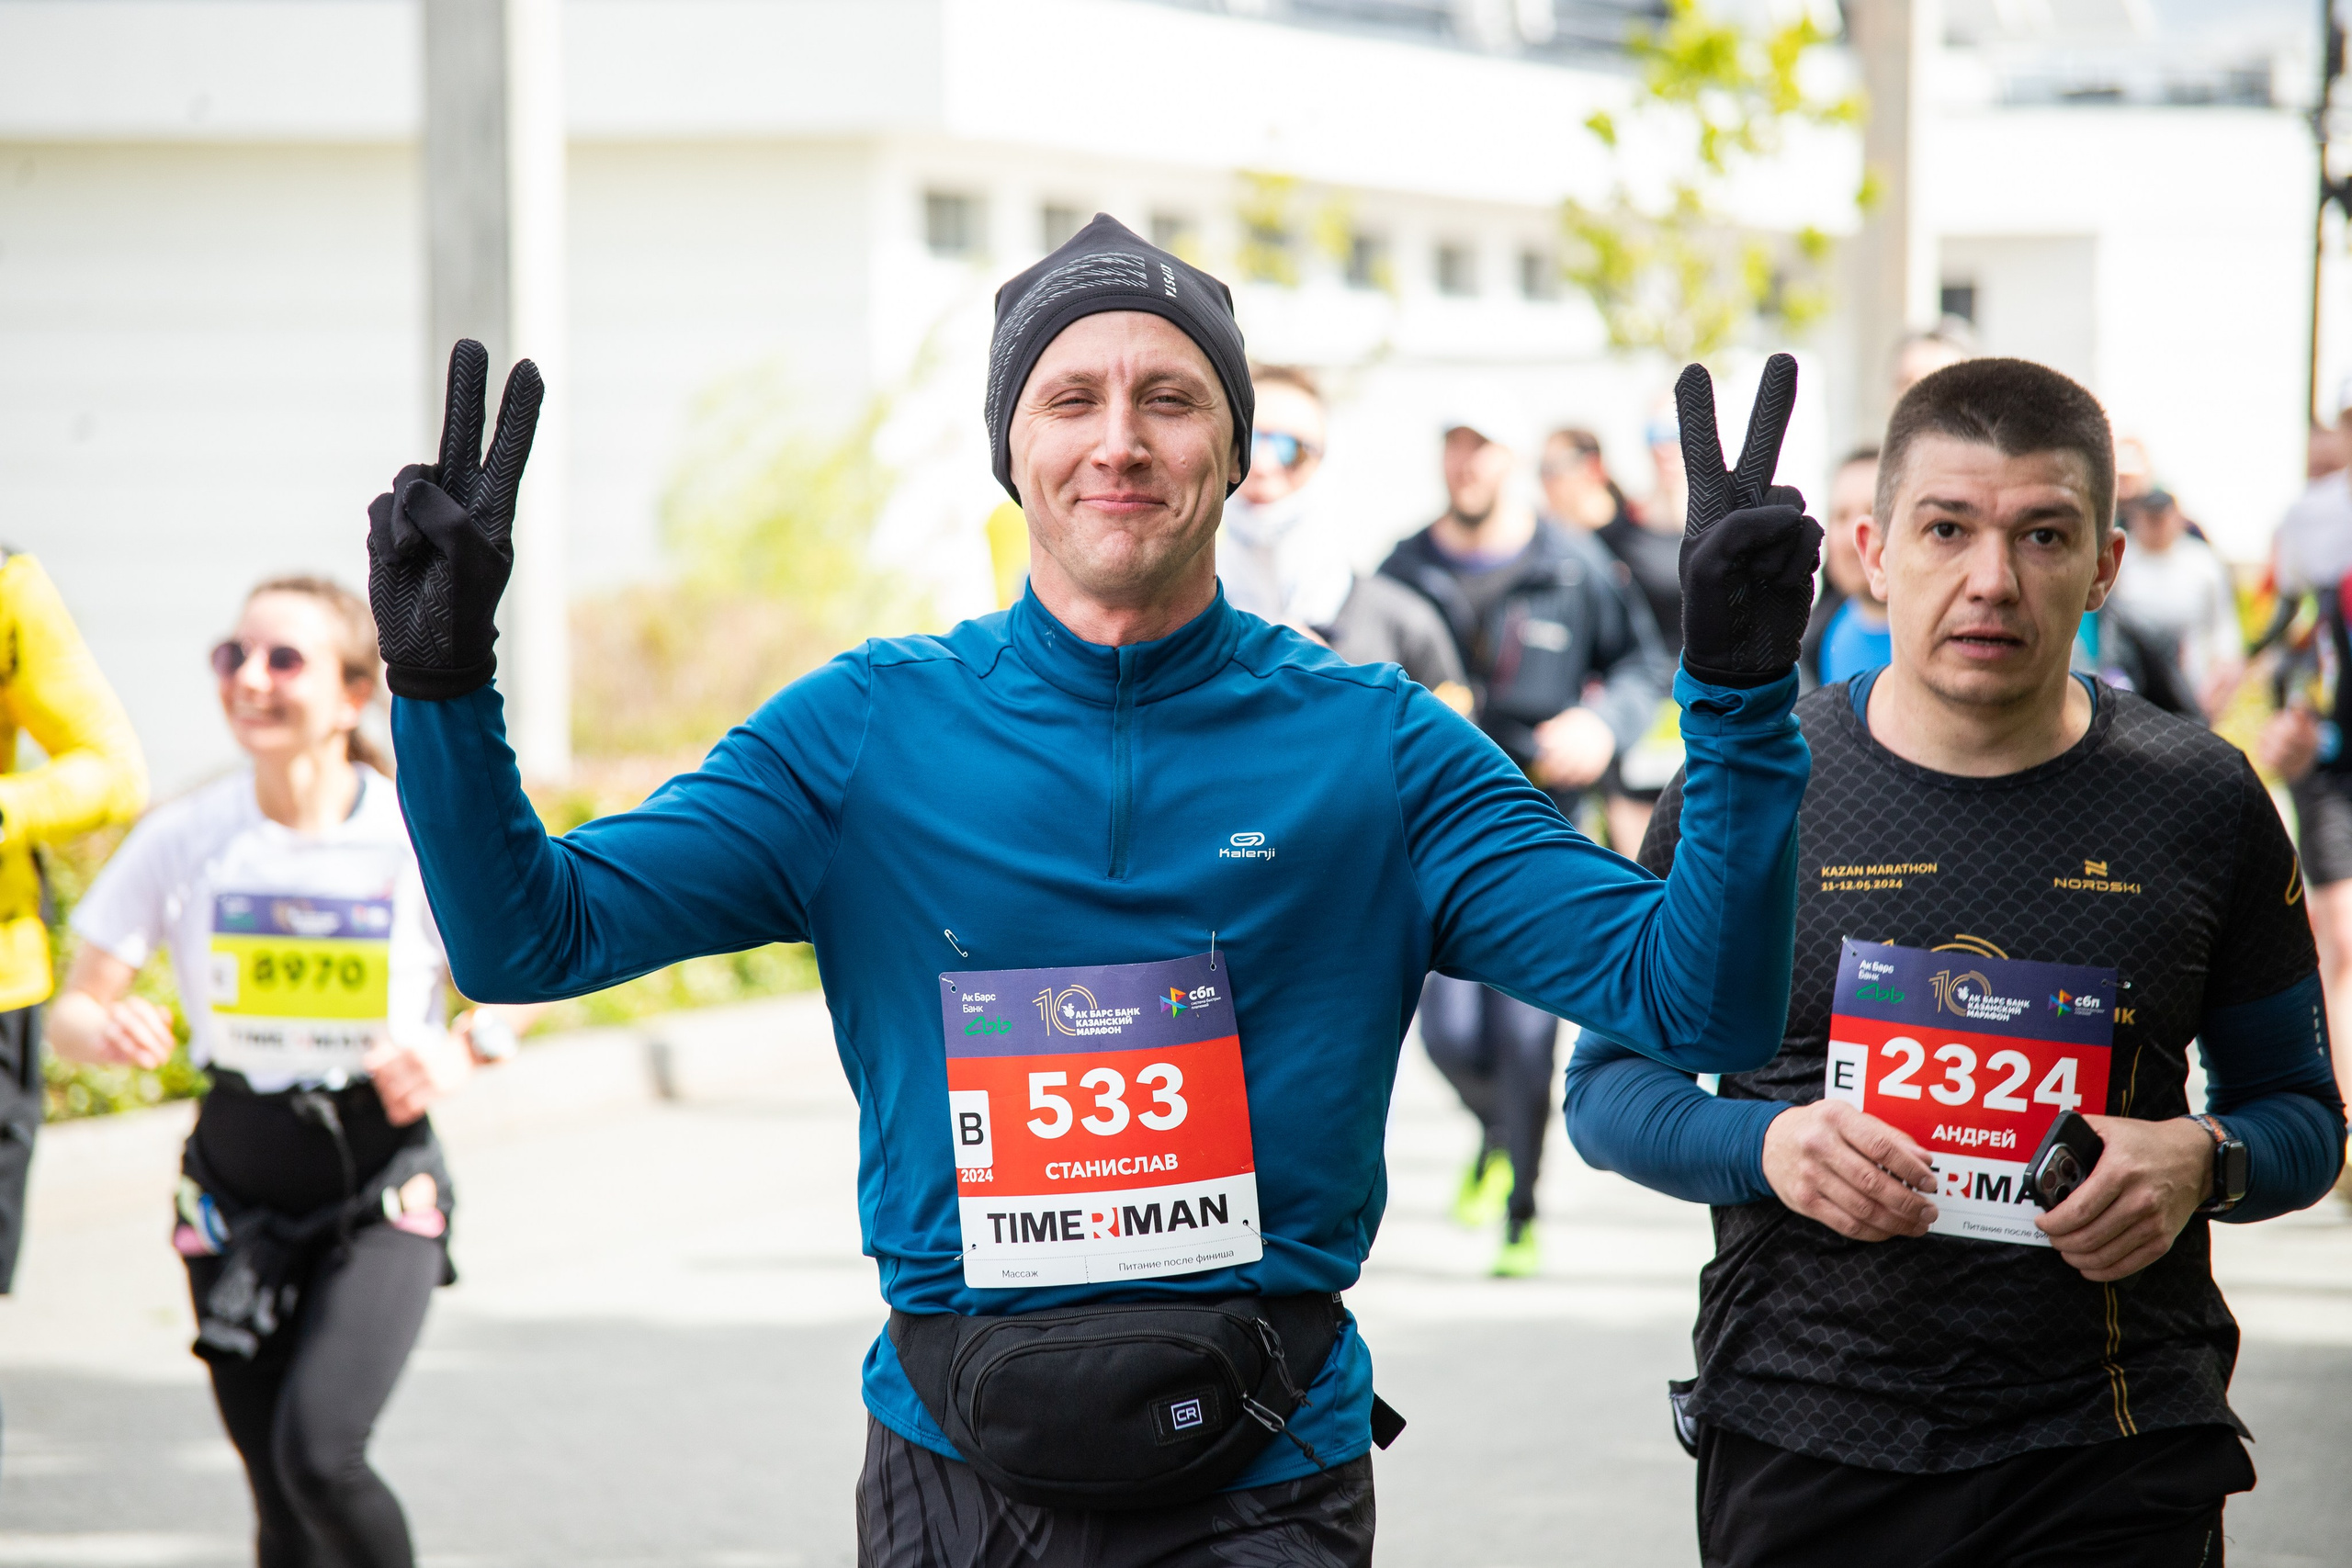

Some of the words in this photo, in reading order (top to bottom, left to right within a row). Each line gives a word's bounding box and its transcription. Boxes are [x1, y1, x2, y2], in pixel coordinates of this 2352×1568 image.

[1219, 848, 1275, 861] Kalenji
[1821, 865, 1864, 877] KAZAN
[1866, 863, 1938, 875] MARATHON
[2053, 877, 2141, 894] NORDSKI
[962, 993, 974, 1001] Ак
[974, 992, 996, 1003] Барс
[1189, 986, 1216, 1000] сбп
[963, 1004, 983, 1013] Банк
[1075, 1010, 1088, 1019] АК
[1090, 1009, 1114, 1018] БАРС
[1114, 1008, 1140, 1017] БАНК
[1075, 1016, 1133, 1027] КАЗАНСКИЙ
[1076, 1026, 1122, 1036] МАРАФОН
[1877, 1036, 2082, 1115] 2324
[1026, 1063, 1188, 1139] 533
[1931, 1123, 2017, 1149] АНДРЕЙ
[1045, 1153, 1179, 1180] СТАНИСЛАВ
[961, 1168, 993, 1183] 2024
[987, 1194, 1228, 1244] TIMERMAN
[1962, 1221, 2002, 1235] Питание
[1118, 1260, 1162, 1272] Питание
[1163, 1258, 1194, 1267] после
[1195, 1250, 1235, 1265] финиша
[1001, 1269, 1039, 1279] Массаж
[1177, 1407, 1197, 1421] CR
